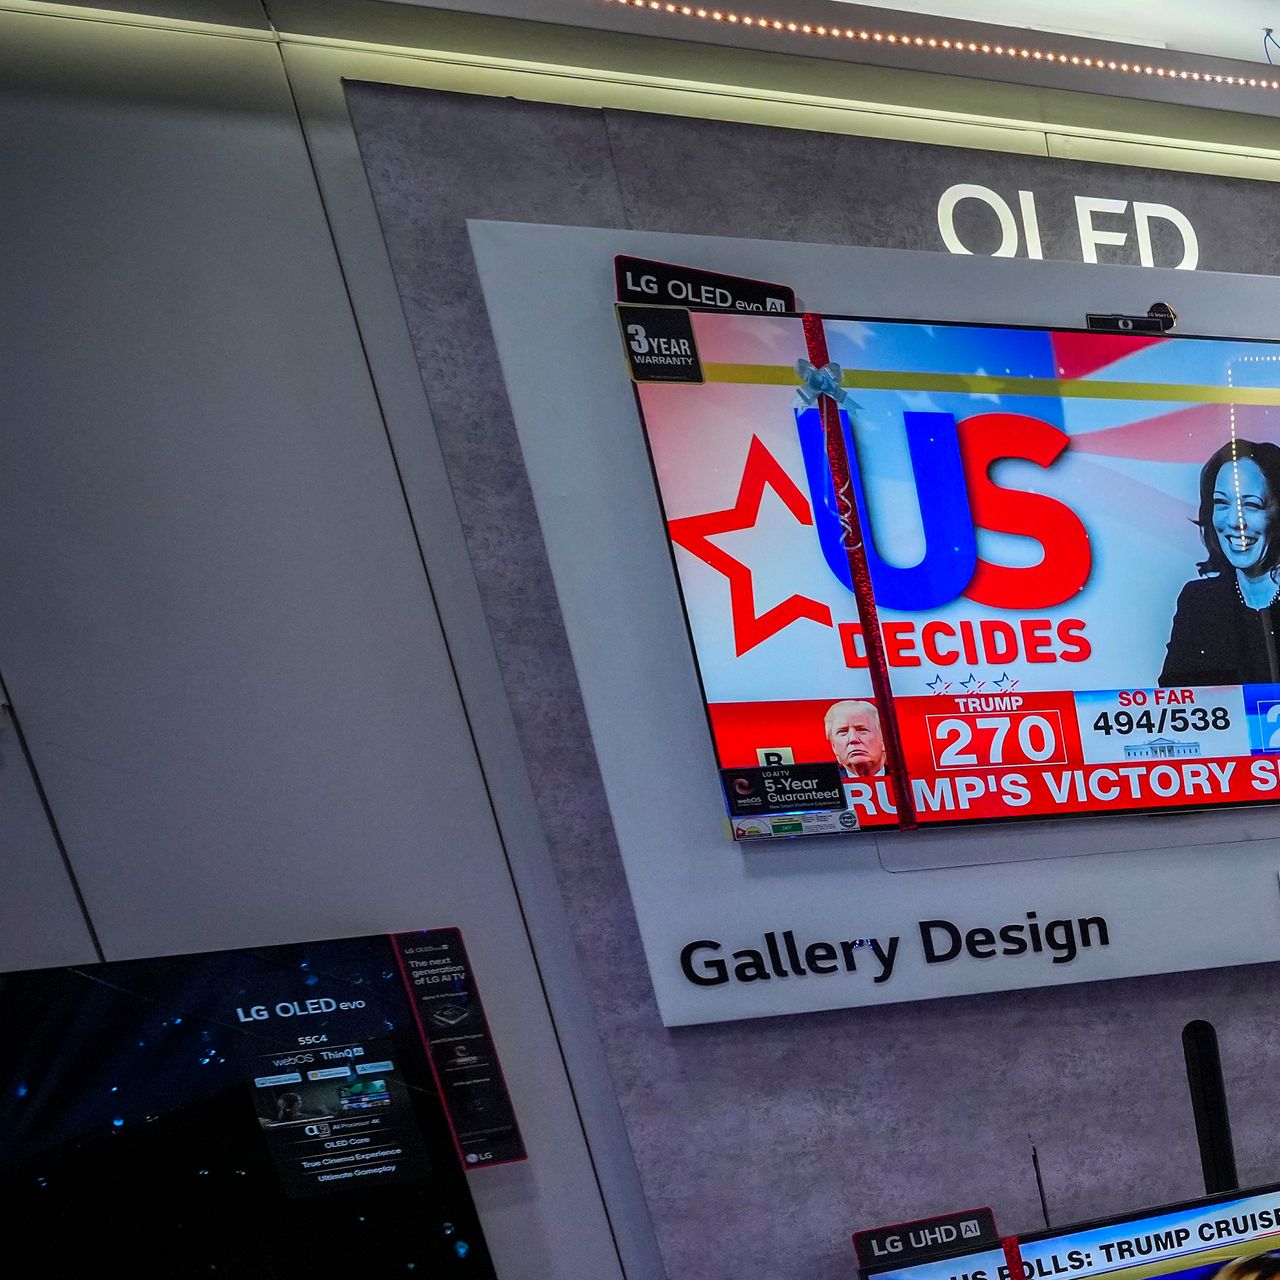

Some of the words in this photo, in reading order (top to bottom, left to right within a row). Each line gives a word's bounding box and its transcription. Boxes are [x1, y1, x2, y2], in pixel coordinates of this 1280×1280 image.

[626, 271, 659, 294] LG
[667, 280, 732, 307] OLED
[633, 355, 694, 366] WARRANTY
[794, 407, 1093, 611] US
[838, 619, 1092, 668] DECIDES
[955, 697, 1024, 713] TRUMP
[1119, 690, 1148, 707] SO
[1154, 688, 1195, 706] FAR
[1093, 706, 1231, 736] 494/538
[935, 714, 1057, 767] 270
[765, 778, 819, 793] 5-Year
[767, 789, 839, 803] Guaranteed
[843, 774, 1031, 817] RUMP'S
[1043, 763, 1236, 804] VICTORY
[679, 930, 900, 988] Gallery
[918, 911, 1111, 967] Design
[409, 959, 427, 968] The
[428, 957, 451, 967] next
[412, 965, 464, 978] generation
[236, 1005, 269, 1022] LG
[275, 997, 336, 1017] OLED
[339, 999, 366, 1010] evo
[298, 1034, 328, 1045] 55C4
[479, 1152, 493, 1161] LG
[317, 1171, 353, 1182] Ultimate
[354, 1165, 396, 1179] Gameplay
[870, 1235, 903, 1257] LG
[909, 1226, 957, 1249] UHD
[961, 1220, 981, 1239] AI
[1099, 1228, 1192, 1263] TRUMP
